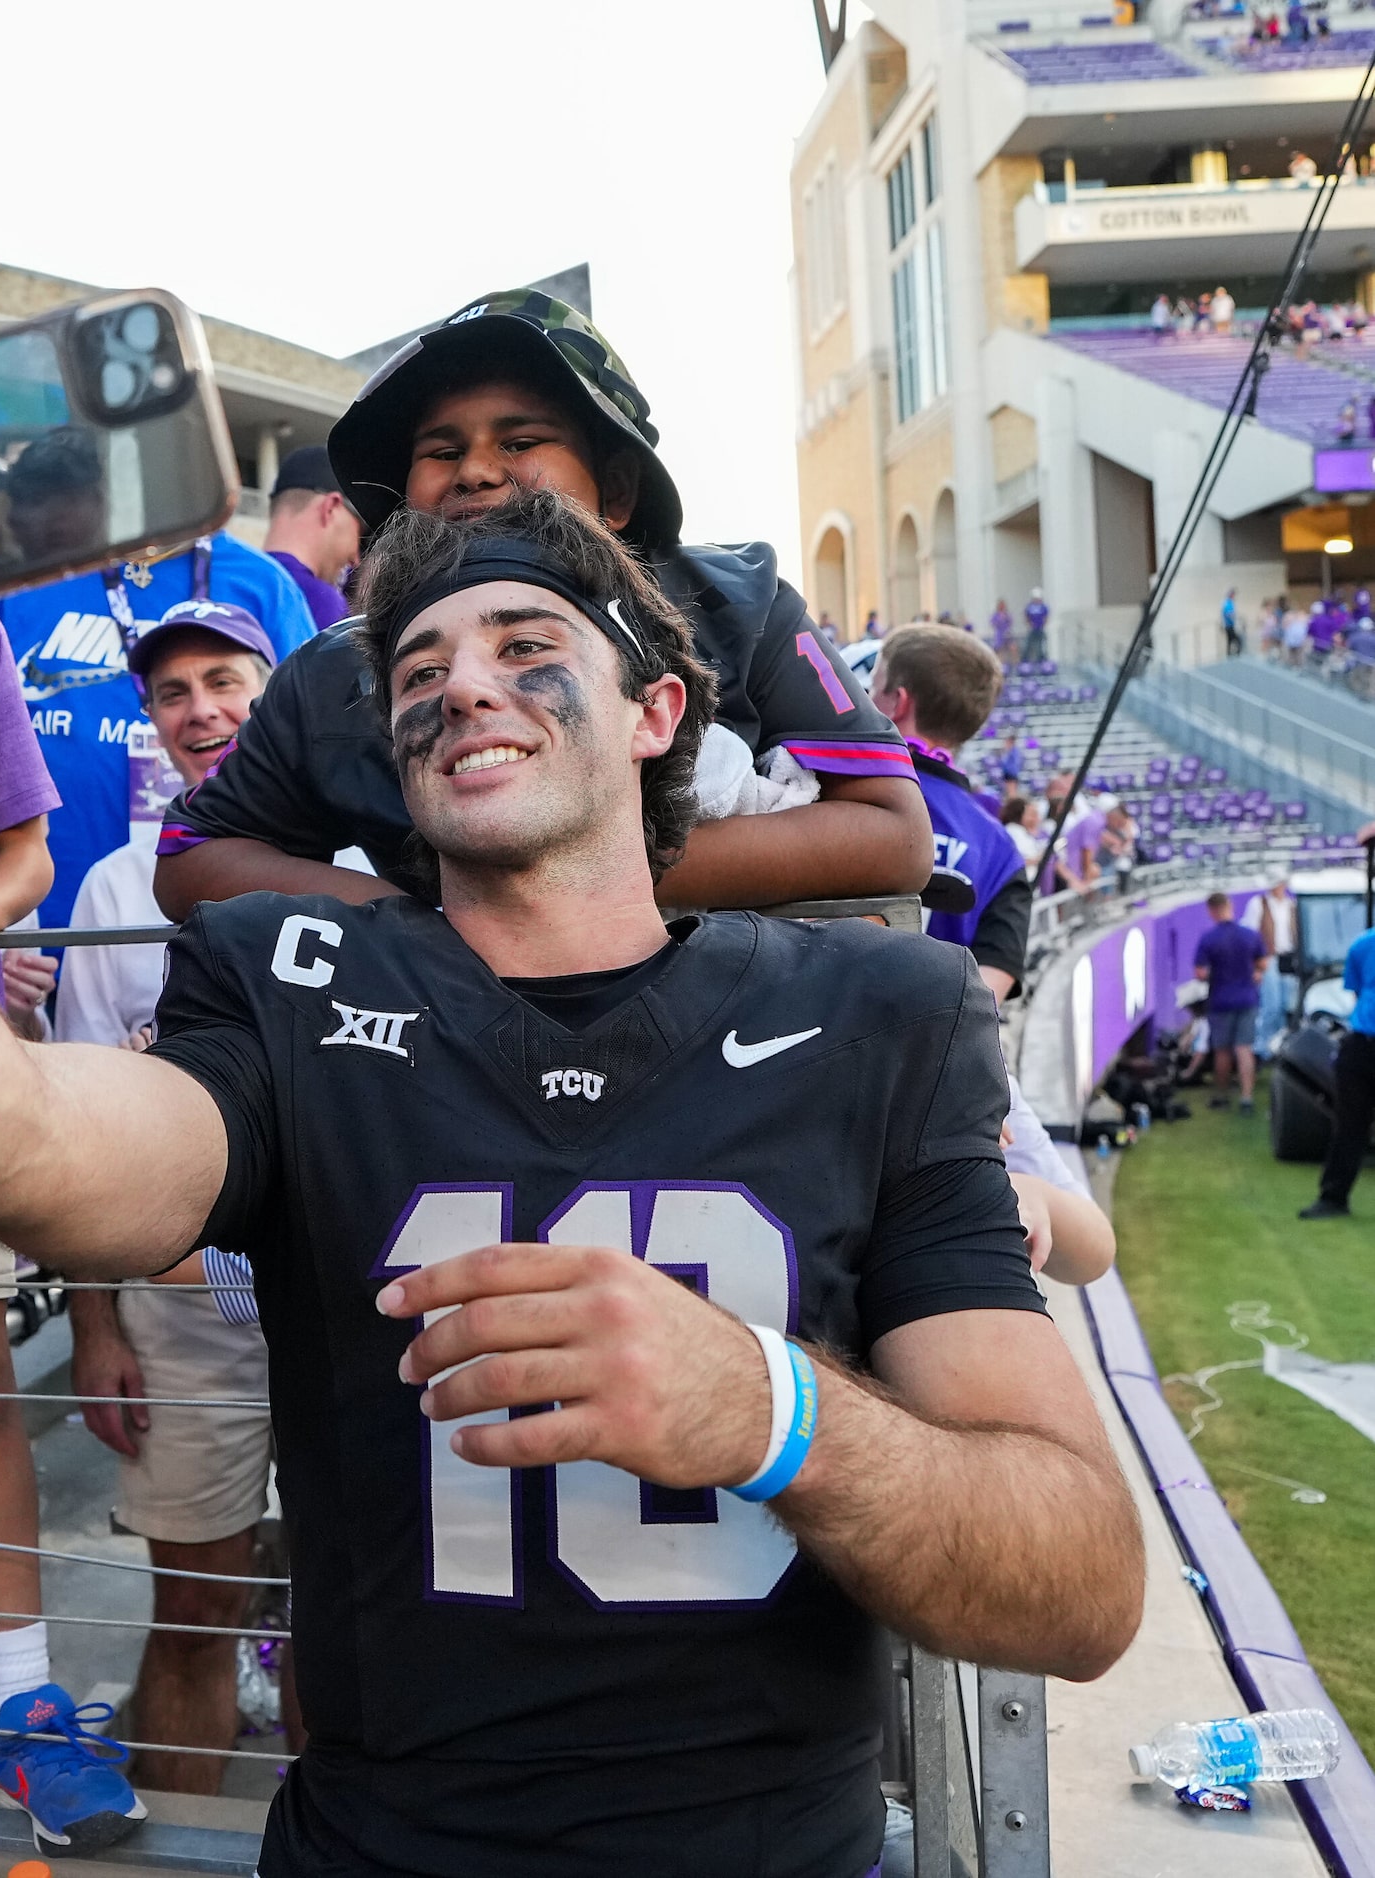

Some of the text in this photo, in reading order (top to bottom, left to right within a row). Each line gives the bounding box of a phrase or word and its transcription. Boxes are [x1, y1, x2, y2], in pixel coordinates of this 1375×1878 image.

[1100, 204, 1251, 230] COTTON BOWL
[795, 631, 855, 715] 1
[32, 709, 73, 737] AIR
[270, 913, 344, 989] C
[319, 1000, 420, 1058] XII
[541, 1069, 605, 1102] TCU
